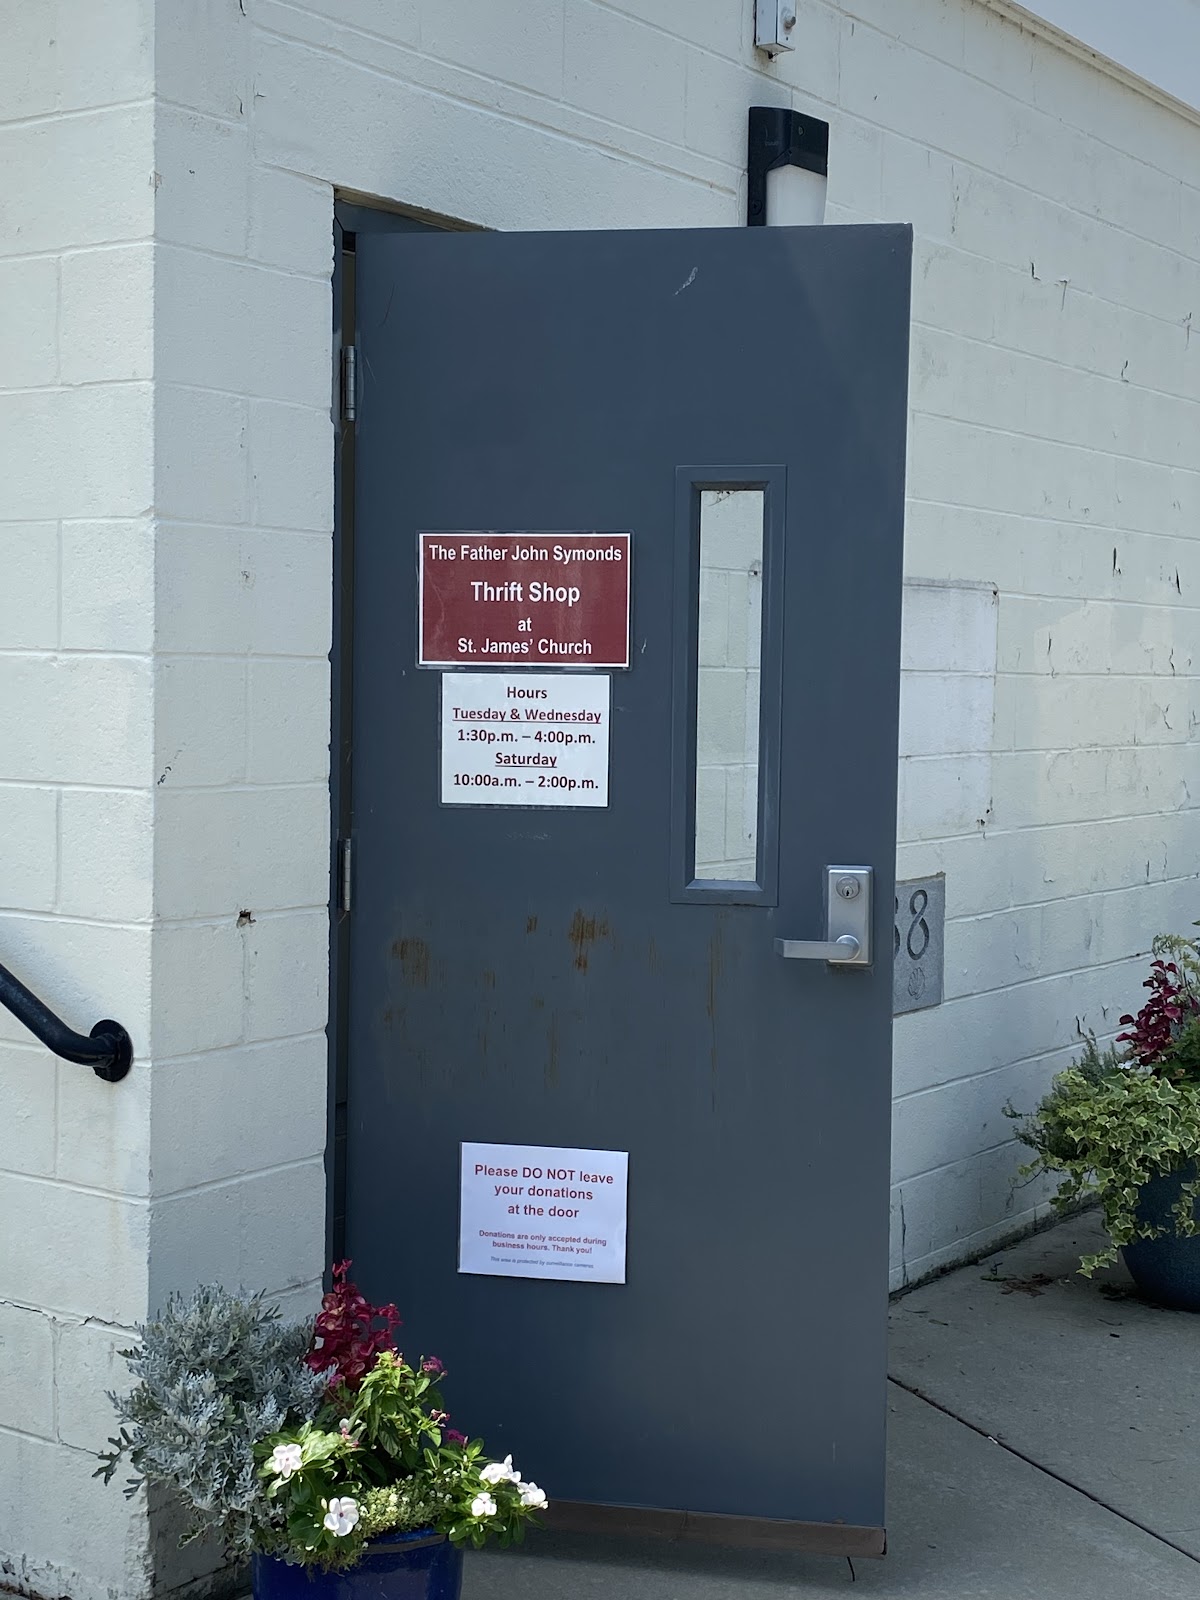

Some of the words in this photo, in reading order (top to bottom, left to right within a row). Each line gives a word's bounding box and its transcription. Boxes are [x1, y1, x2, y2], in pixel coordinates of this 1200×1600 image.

[428, 544, 456, 561] The
[460, 544, 508, 561] Father
[511, 545, 549, 561] John
[552, 545, 622, 565] Symonds
[470, 581, 523, 602] Thrift
[528, 581, 580, 607] Shop
[517, 617, 532, 632] at
[457, 637, 477, 654] St.
[481, 638, 533, 654] James’
[537, 638, 592, 655] Church
[506, 686, 548, 699] Hours
[452, 707, 507, 722] Tuesday
[510, 708, 521, 720] &
[524, 709, 602, 724] Wednesday
[457, 729, 518, 744] 1:30p.m.
[534, 731, 596, 746] 4:00p.m.
[495, 752, 557, 768] Saturday
[453, 773, 521, 787] 10:00a.m.
[537, 775, 599, 791] 2:00p.m.
[894, 889, 930, 961] 8
[474, 1164, 518, 1178] Please
[522, 1167, 543, 1179] DO
[547, 1168, 575, 1181] NOT
[579, 1171, 614, 1184] leave
[494, 1185, 524, 1196] your
[527, 1185, 593, 1200] donations
[507, 1204, 520, 1215] at
[523, 1204, 544, 1216] the
[548, 1206, 579, 1218] door
[479, 1229, 515, 1239] Donations
[530, 1233, 546, 1242] only
[548, 1235, 581, 1244] accepted
[582, 1237, 607, 1247] during
[492, 1240, 525, 1249] business
[526, 1242, 550, 1251] hours.
[552, 1244, 574, 1253] Thank
